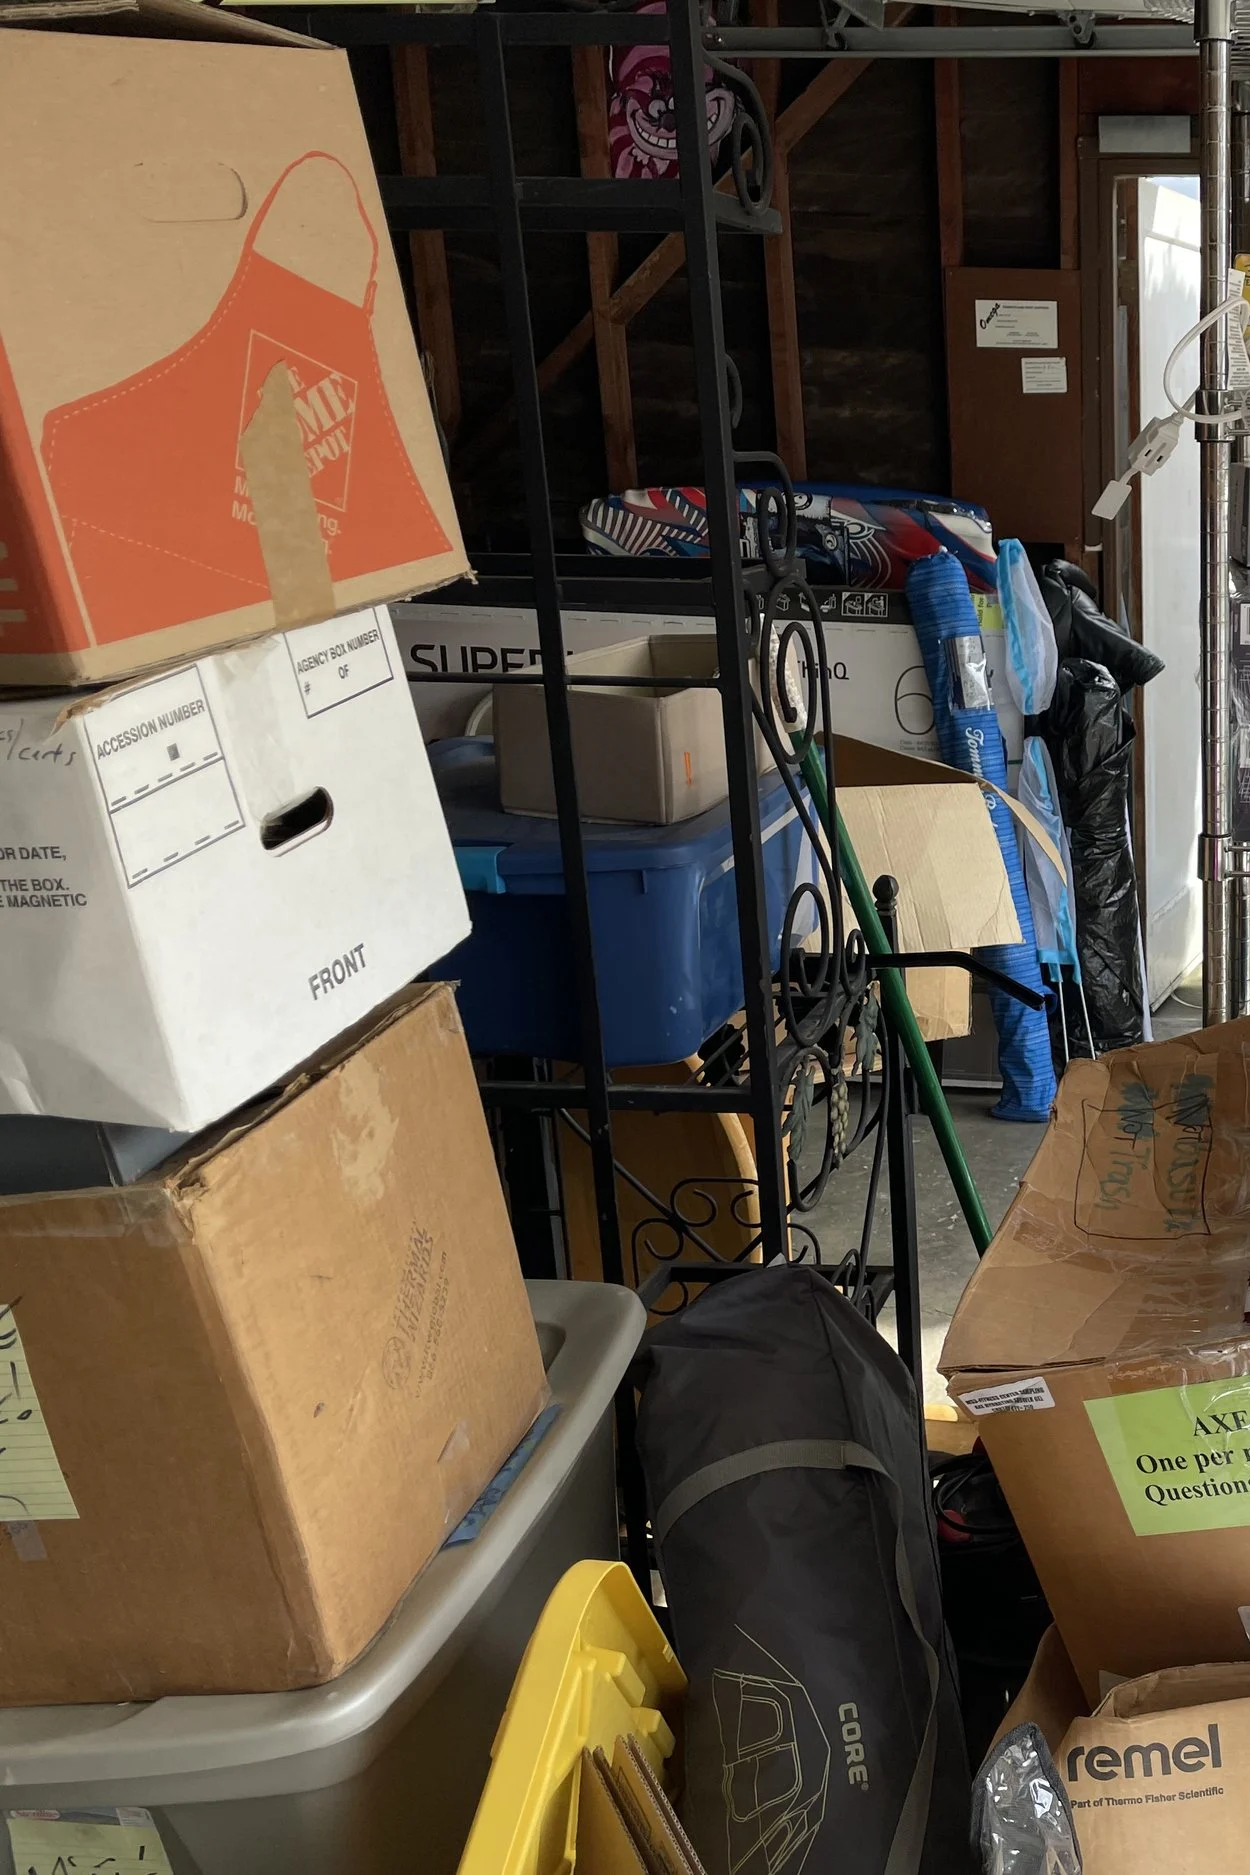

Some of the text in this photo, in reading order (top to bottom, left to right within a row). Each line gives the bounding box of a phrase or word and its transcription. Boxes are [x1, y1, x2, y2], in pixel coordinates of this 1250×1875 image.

[296, 628, 380, 675] AGENCY BOX NUMBER
[337, 665, 350, 680] OF
[96, 698, 206, 760] ACCESSION NUMBER
[20, 846, 67, 861] DATE,
[1, 878, 70, 892] THE BOX.
[7, 893, 87, 908] MAGNETIC
[308, 943, 367, 1002] FRONT
[1136, 1453, 1188, 1475] One
[1194, 1450, 1234, 1474] per
[839, 1702, 869, 1785] CORE
[1067, 1723, 1222, 1782] remel
[1071, 1786, 1224, 1809] Part of Thermo Fisher Scientific
